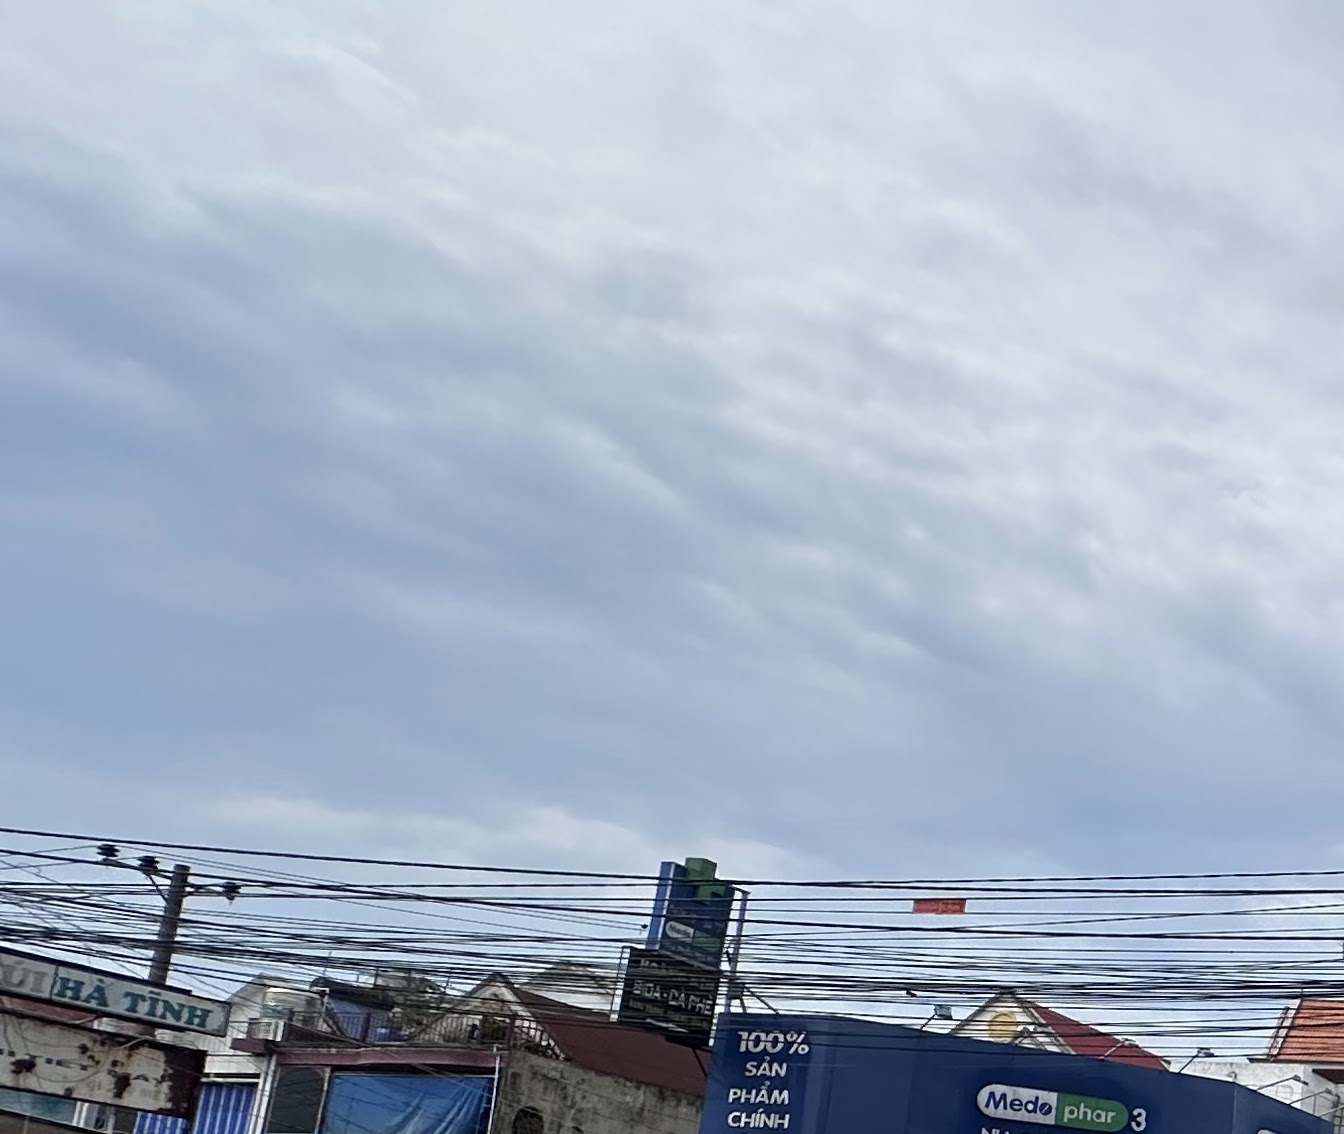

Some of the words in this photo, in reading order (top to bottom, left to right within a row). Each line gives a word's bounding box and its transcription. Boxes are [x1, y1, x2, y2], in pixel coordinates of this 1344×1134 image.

[55, 976, 109, 1007] HÀ
[738, 1030, 809, 1054] 100%
[745, 1056, 788, 1077] SẢN
[728, 1081, 790, 1104] PHẨM
[727, 1108, 790, 1129] CHÍNH
[1131, 1108, 1147, 1132] 3
